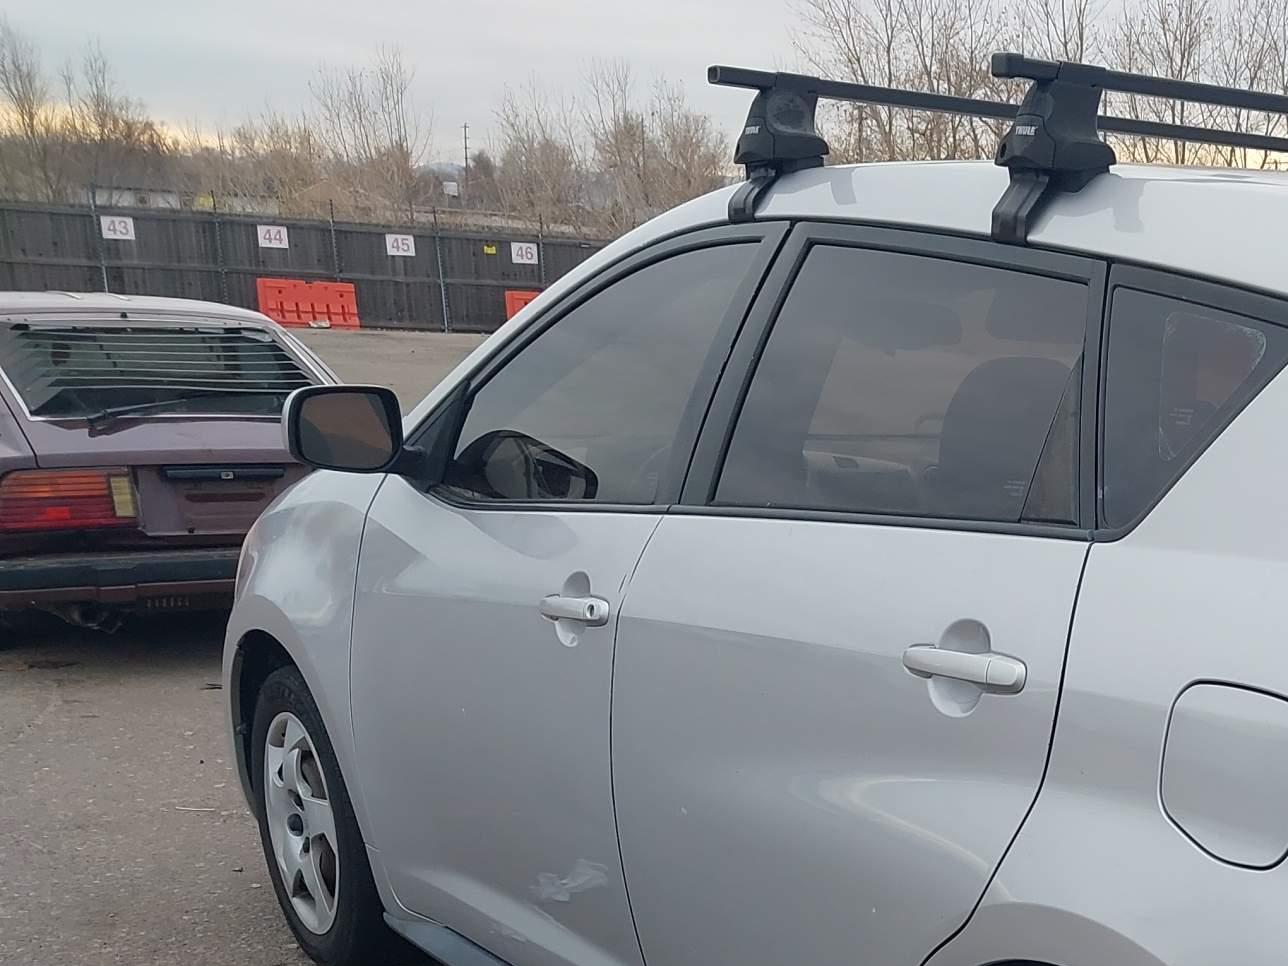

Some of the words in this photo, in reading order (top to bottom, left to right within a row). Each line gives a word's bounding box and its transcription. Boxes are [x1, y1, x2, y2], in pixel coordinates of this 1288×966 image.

[107, 219, 129, 236] 43
[263, 229, 284, 244] 44
[391, 238, 410, 253] 45
[516, 246, 534, 260] 46
